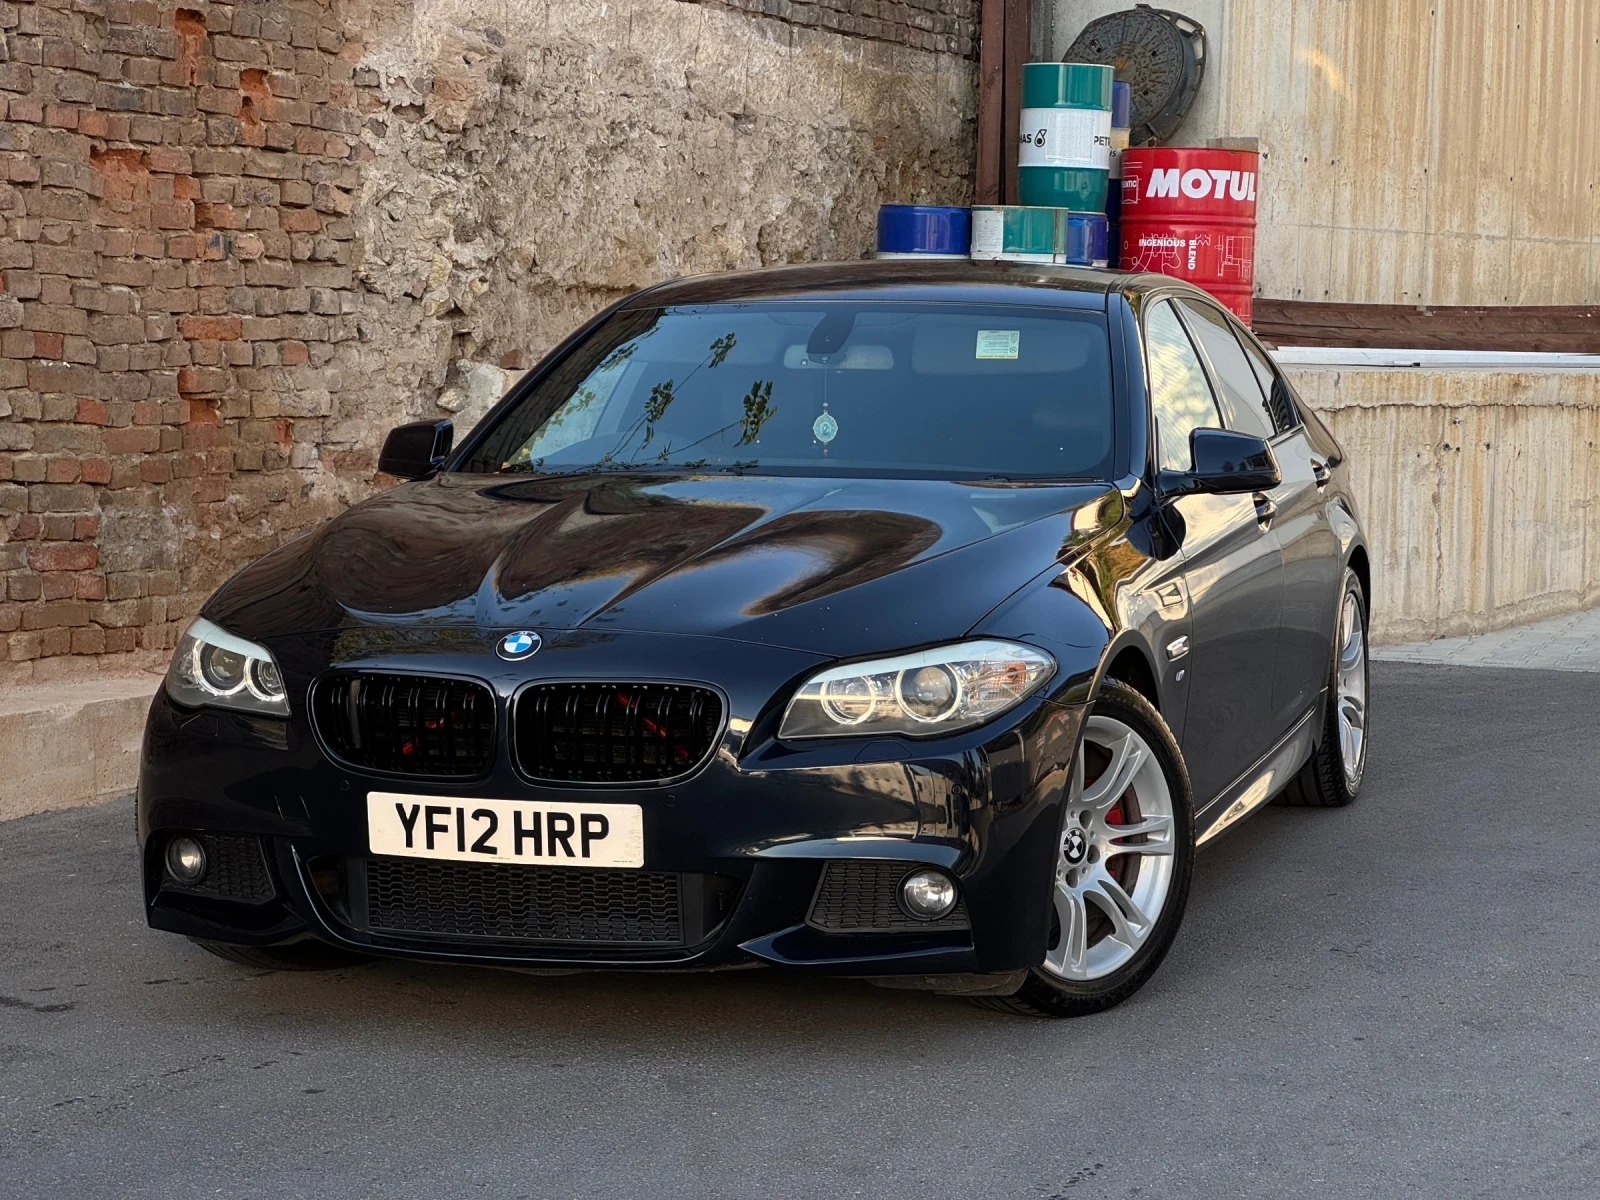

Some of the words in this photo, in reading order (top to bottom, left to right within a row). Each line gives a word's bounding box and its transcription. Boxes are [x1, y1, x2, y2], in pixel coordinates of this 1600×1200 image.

[1146, 168, 1256, 201] MOTUL
[1139, 239, 1186, 247] INGENIOUS
[1187, 239, 1197, 270] BLEND
[395, 802, 498, 855] YF12
[513, 810, 609, 858] HRP
